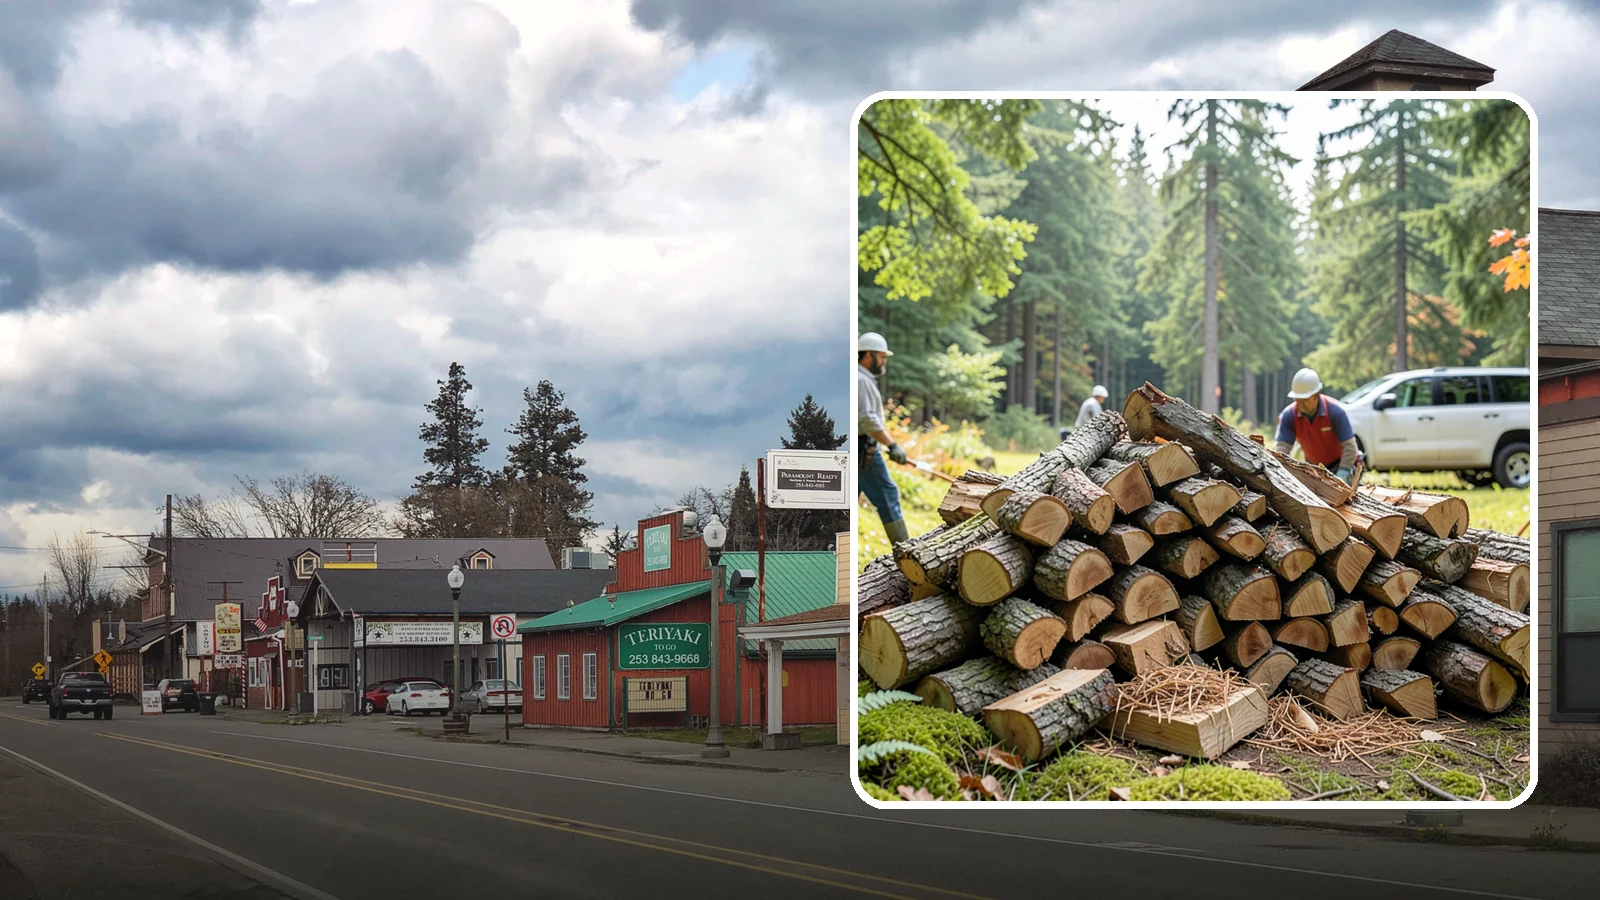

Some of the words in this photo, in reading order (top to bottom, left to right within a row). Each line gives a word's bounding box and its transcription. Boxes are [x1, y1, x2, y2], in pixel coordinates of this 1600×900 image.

[624, 627, 702, 646] TERIYAKI
[629, 654, 648, 664] 253
[651, 654, 700, 664] 843-9668
